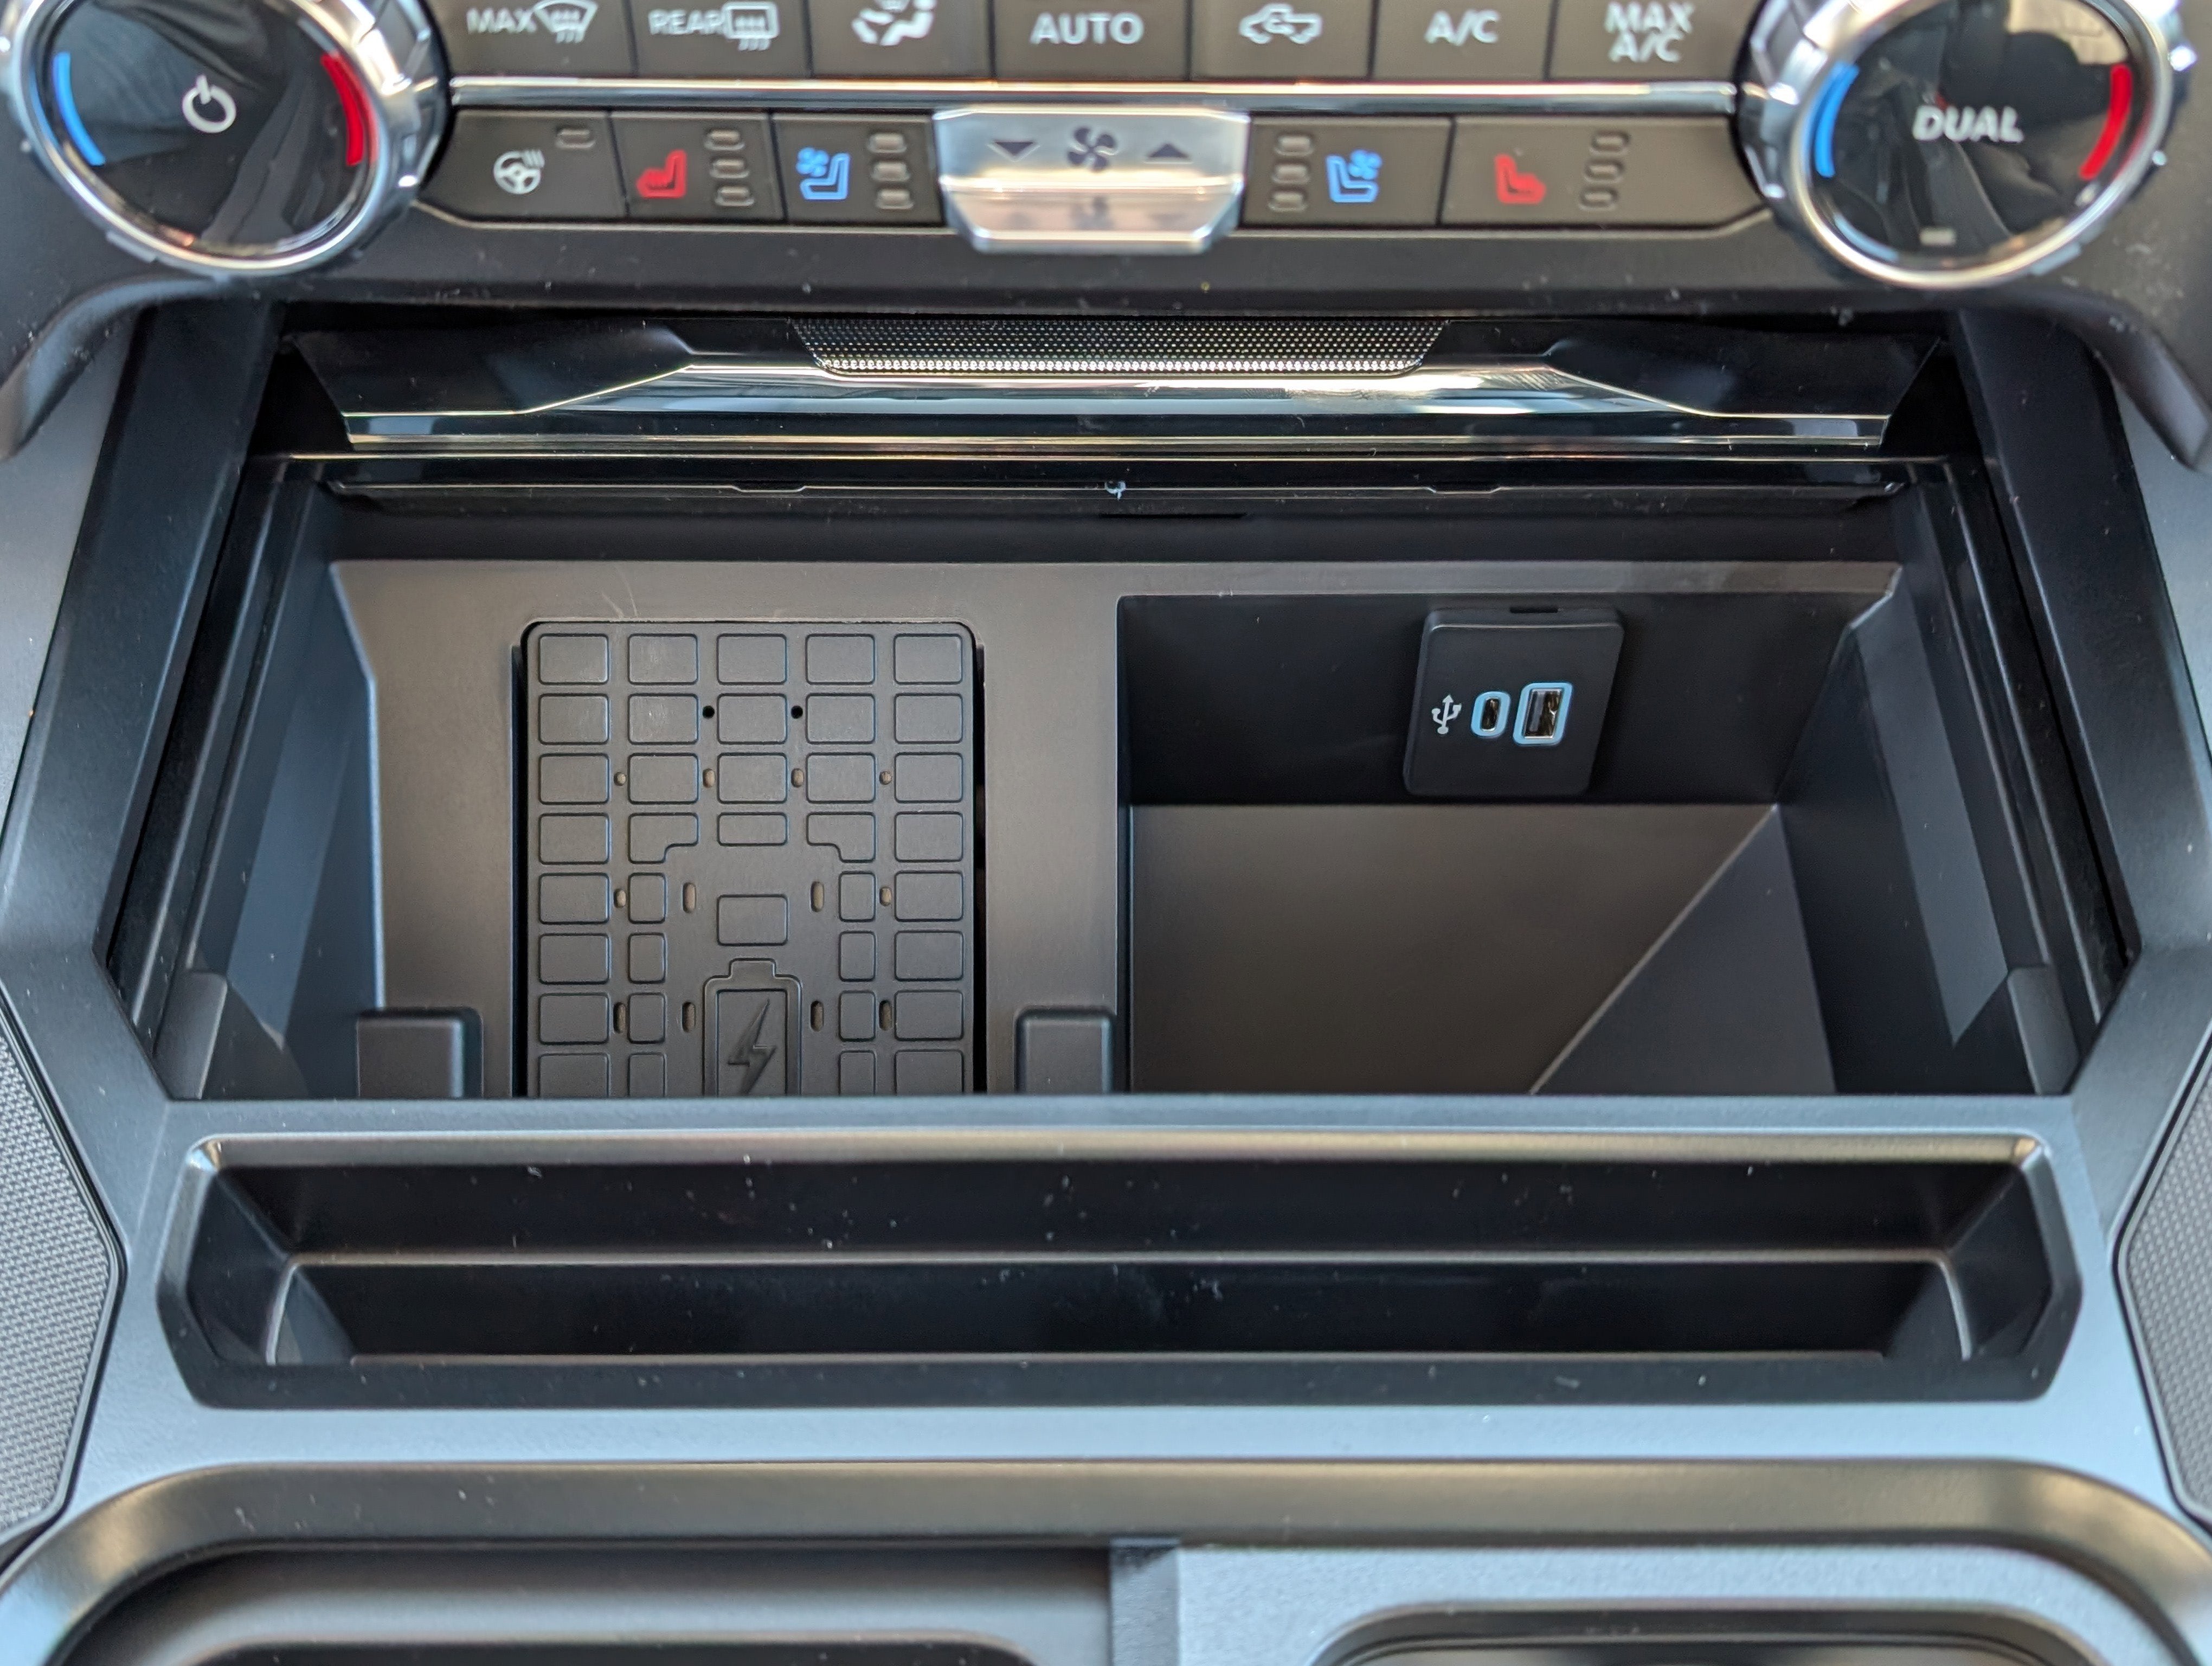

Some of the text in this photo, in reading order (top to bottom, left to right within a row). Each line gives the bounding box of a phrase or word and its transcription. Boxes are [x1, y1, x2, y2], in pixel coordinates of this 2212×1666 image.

[466, 8, 537, 34] MAX
[648, 9, 725, 35] REAR
[1031, 12, 1144, 44] AUTO
[1425, 10, 1500, 46] A/C
[1604, 1, 1694, 34] MAX
[1608, 31, 1683, 62] A/C
[1912, 105, 2024, 143] DUAL
